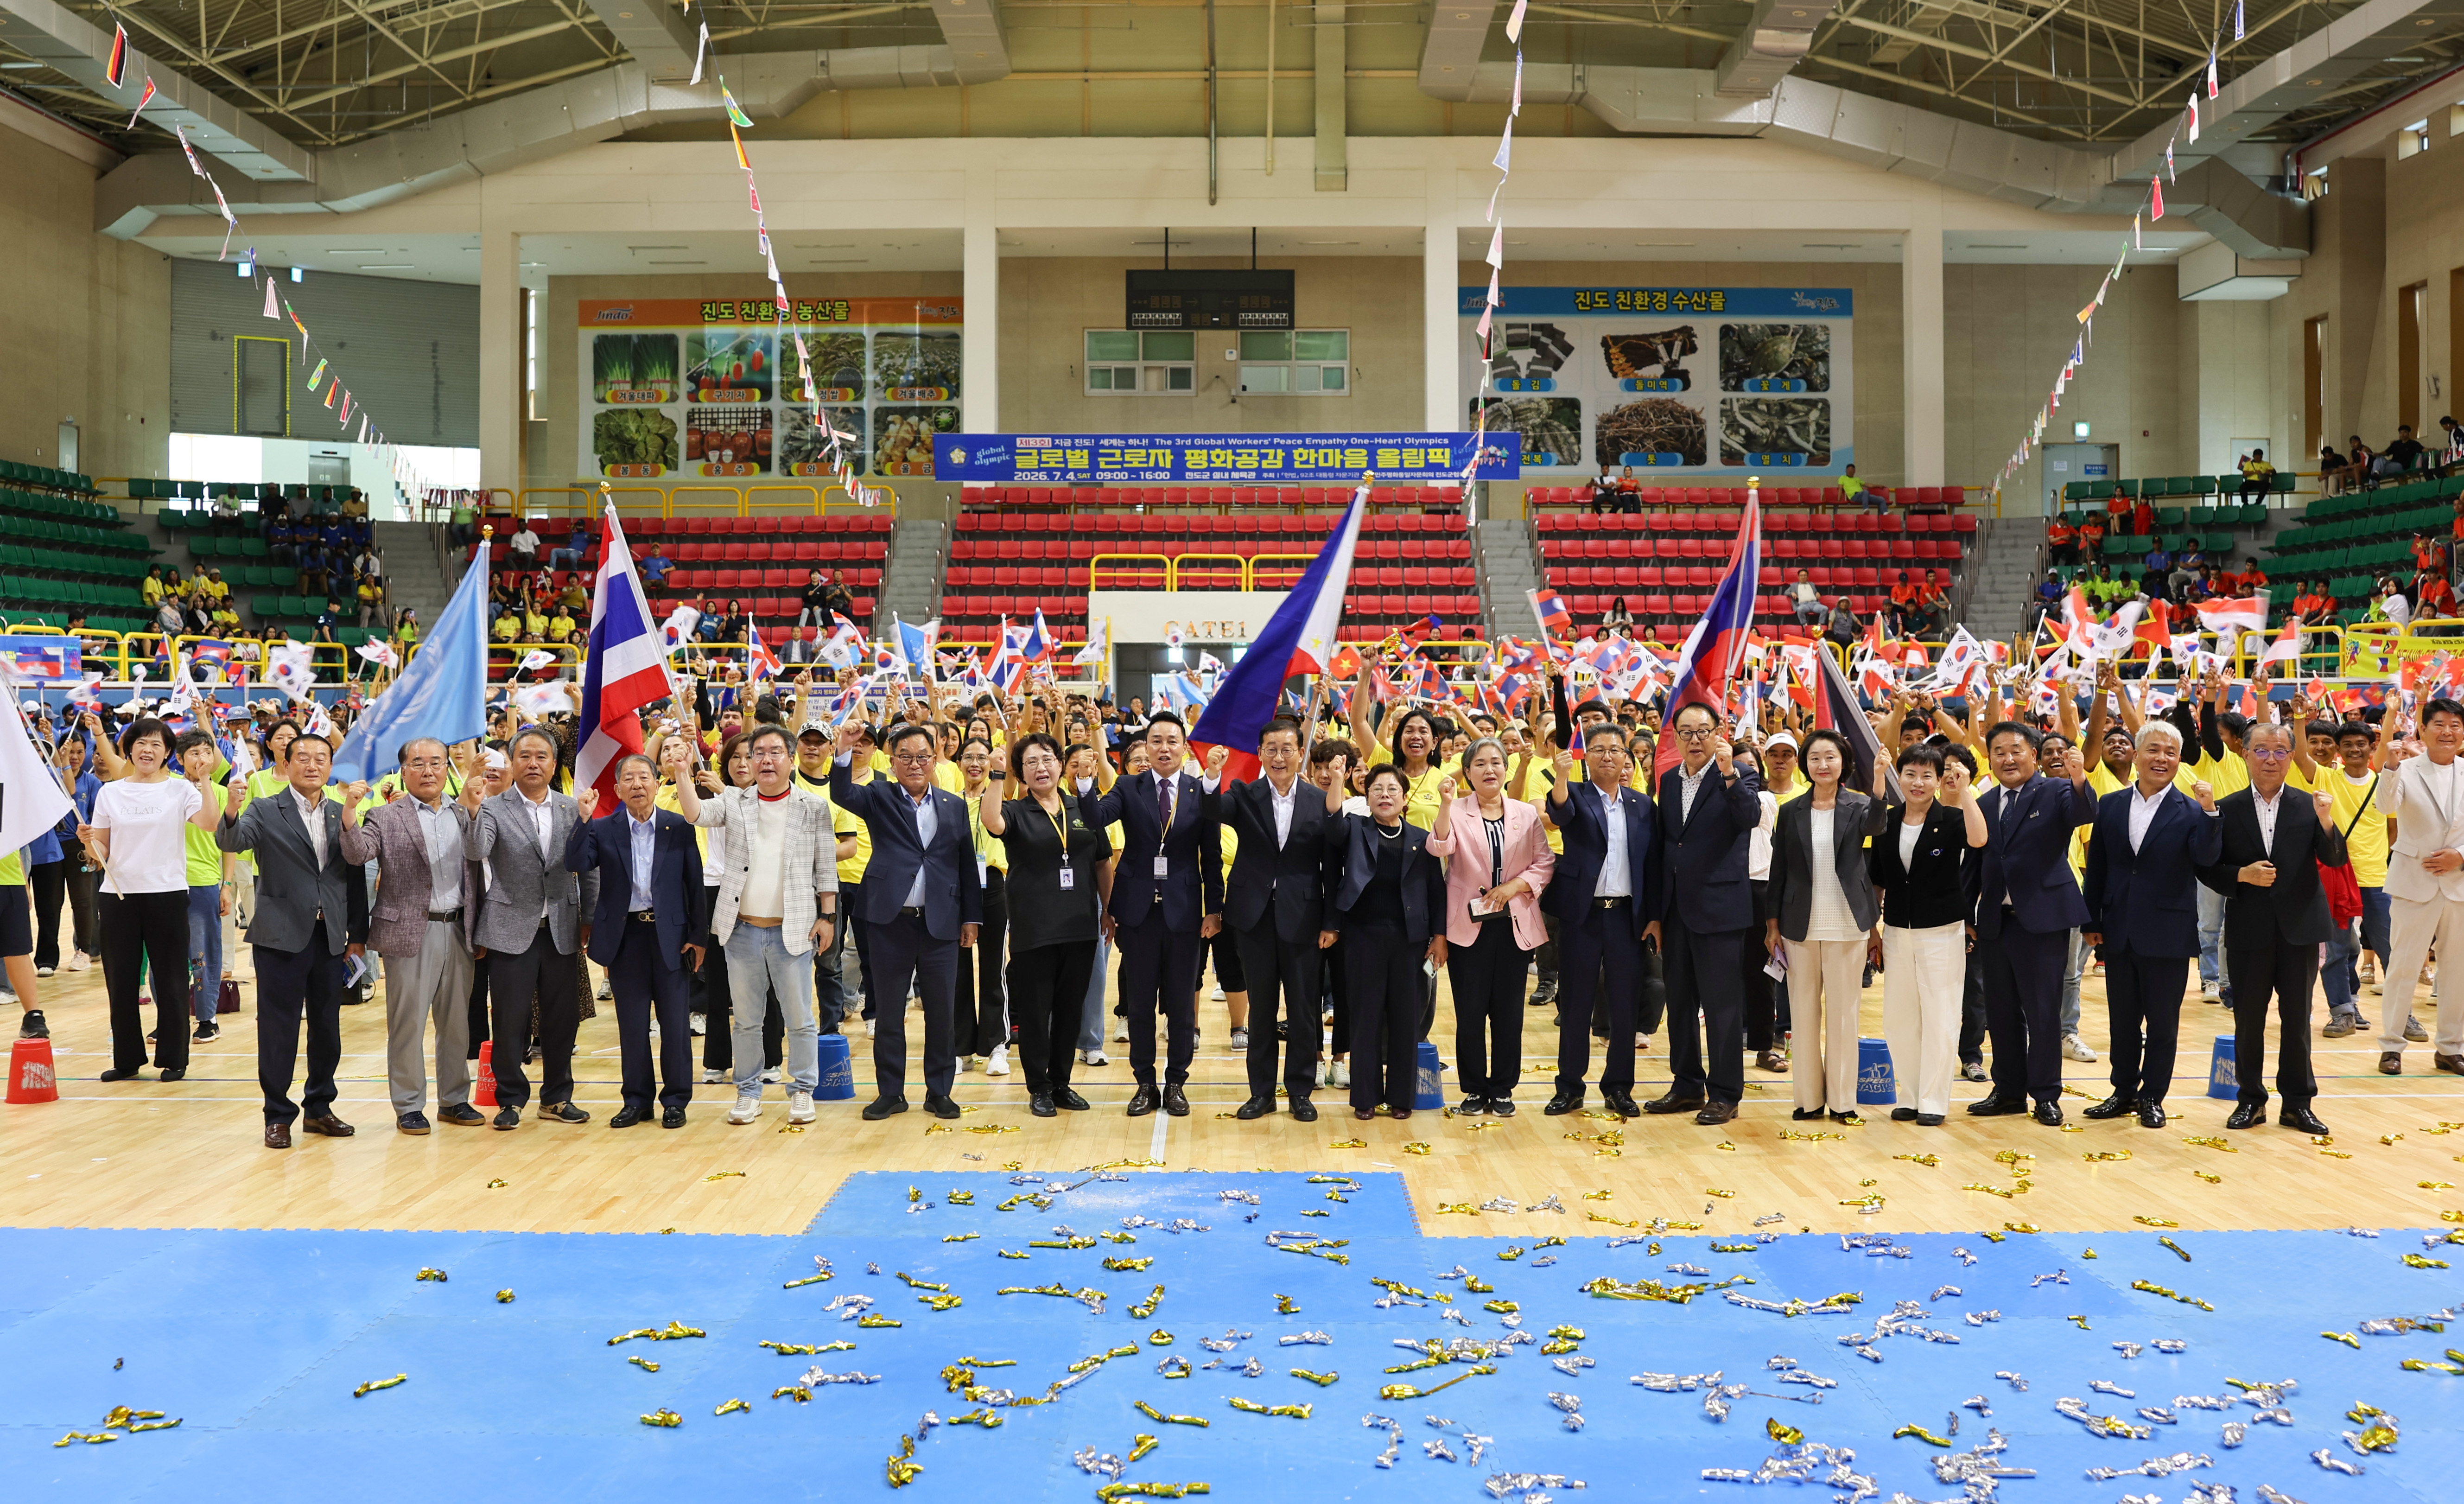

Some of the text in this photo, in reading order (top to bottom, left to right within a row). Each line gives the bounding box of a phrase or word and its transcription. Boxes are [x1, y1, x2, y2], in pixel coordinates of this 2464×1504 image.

[1575, 291, 1726, 311] 진도 친환경 수산물
[701, 302, 736, 321] 진도
[797, 301, 850, 321] 농산물
[1635, 380, 1668, 391] 돌미역
[618, 390, 655, 401] 겨울대파
[713, 390, 746, 401] 구기자
[898, 388, 936, 399] 겨울배추
[1404, 437, 1449, 446] Olympics
[976, 445, 1005, 458] global
[975, 452, 1010, 465] olympic
[1015, 449, 1089, 469] 글로벌
[1098, 449, 1174, 469] 근로자
[1185, 448, 1285, 469] 평화공감
[1293, 448, 1368, 468] 한마음
[1376, 448, 1451, 468] 올림픽
[1014, 472, 1049, 480] 2026.
[1053, 472, 1063, 480] 7.
[1096, 472, 1128, 480] 09:00
[1139, 472, 1170, 480] 16:00
[2216, 1056, 2235, 1077] JUM
[1857, 1083, 1895, 1093] TACKS
